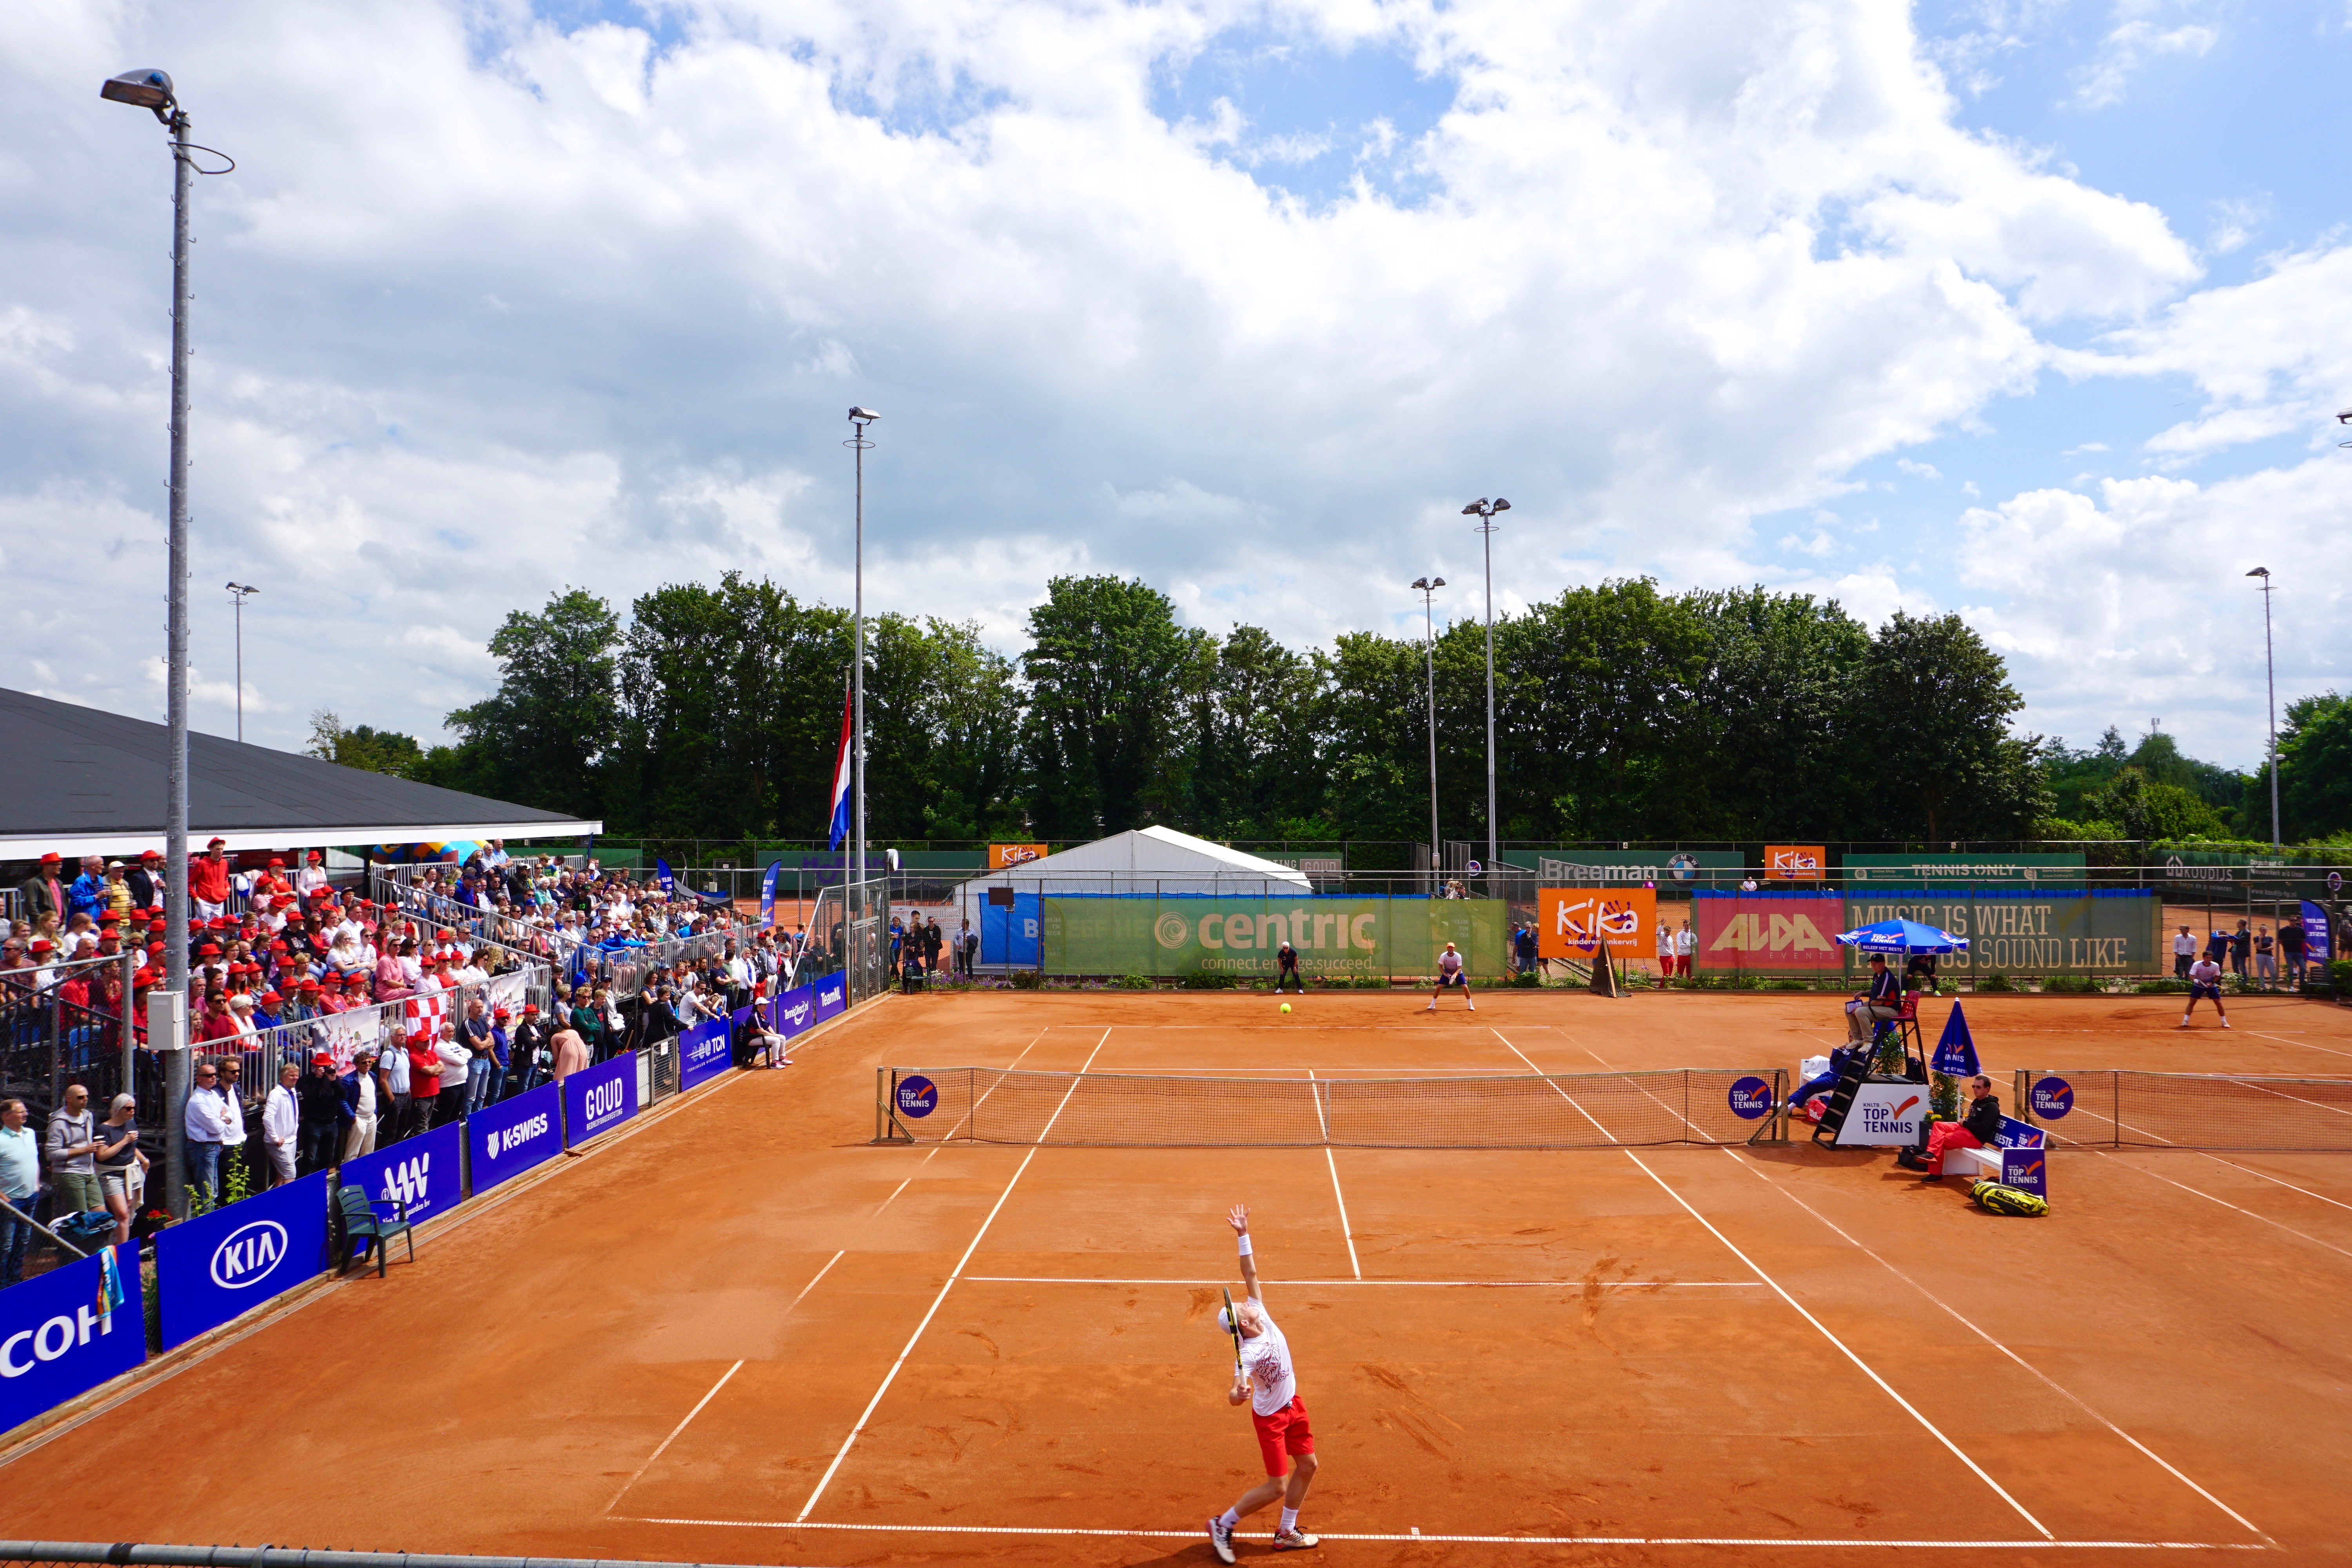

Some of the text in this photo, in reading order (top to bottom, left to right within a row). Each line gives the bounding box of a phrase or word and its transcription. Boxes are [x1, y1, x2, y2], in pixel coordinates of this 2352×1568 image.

[1670, 854, 1698, 866] BMW
[1545, 860, 1658, 880] Breeman
[1912, 864, 2016, 876] TENNIS ONLY
[2184, 868, 2232, 880] KOUDIJS
[1198, 908, 1376, 949] centric
[1943, 906, 1967, 935] IS
[1974, 906, 2051, 935] WHAT
[1708, 914, 1834, 951] ALDA
[1568, 938, 1637, 946] kinderennkervrij
[1979, 938, 2062, 968] SOUND
[2070, 938, 2127, 967] LIKE
[1201, 956, 1376, 973] connect.enge.succeed.
[821, 986, 841, 1007] TeamNL
[711, 1034, 725, 1054] TCN
[687, 1062, 706, 1073] TENNISCLUB
[586, 1078, 622, 1120] GOUD
[2035, 1101, 2065, 1109] TENNIS
[586, 1107, 623, 1131] BEDRIJFSHUISVESTING
[1863, 1109, 1889, 1120] TOP
[1863, 1121, 1913, 1133] TENNIS
[1994, 1132, 2013, 1148] BESTE.
[2019, 1136, 2028, 1145] TOP
[424, 1199, 430, 1208] bv
[224, 1231, 276, 1279] KIA
[0, 1305, 112, 1378] COH
